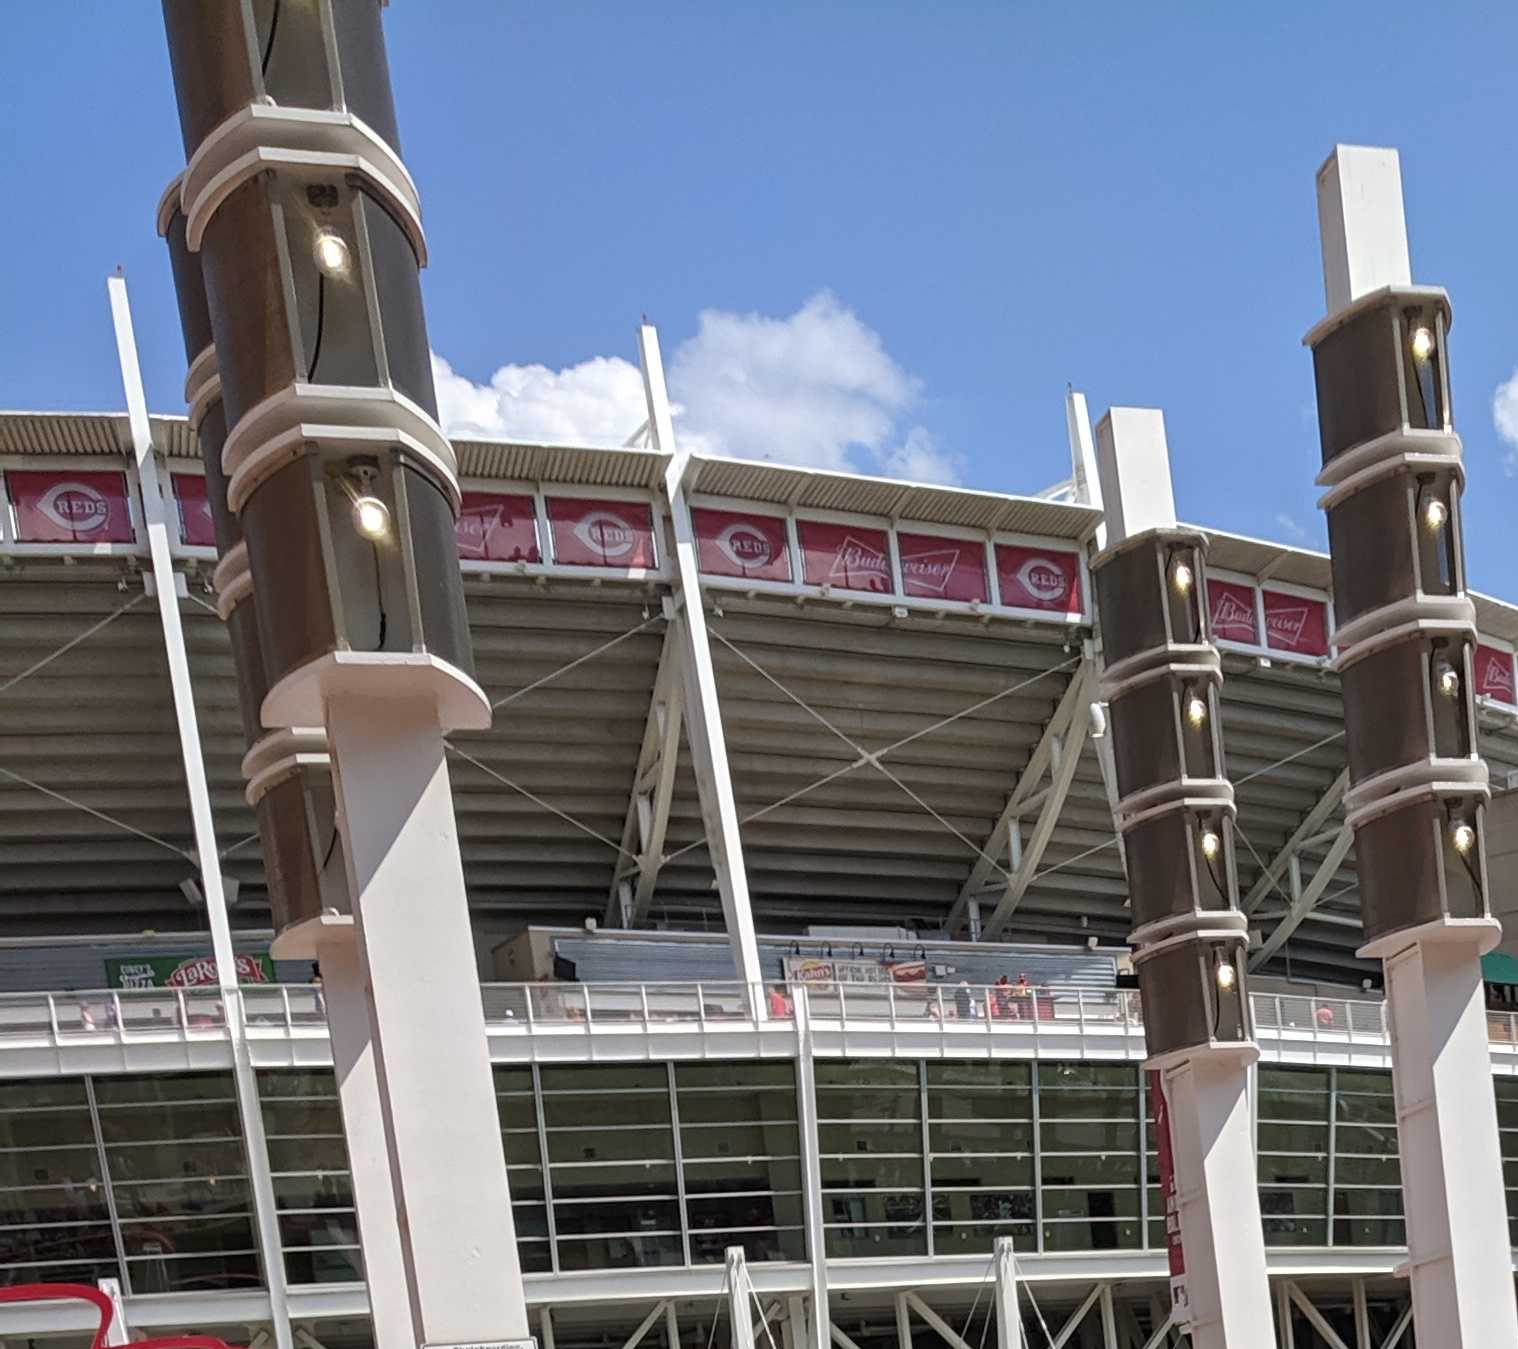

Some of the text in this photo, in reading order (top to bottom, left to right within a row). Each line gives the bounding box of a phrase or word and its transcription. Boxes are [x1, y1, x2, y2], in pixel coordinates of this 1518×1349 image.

[56, 499, 107, 514] REDS
[591, 527, 633, 543] REDS
[730, 539, 769, 554] REDS
[1030, 571, 1066, 587] REDS
